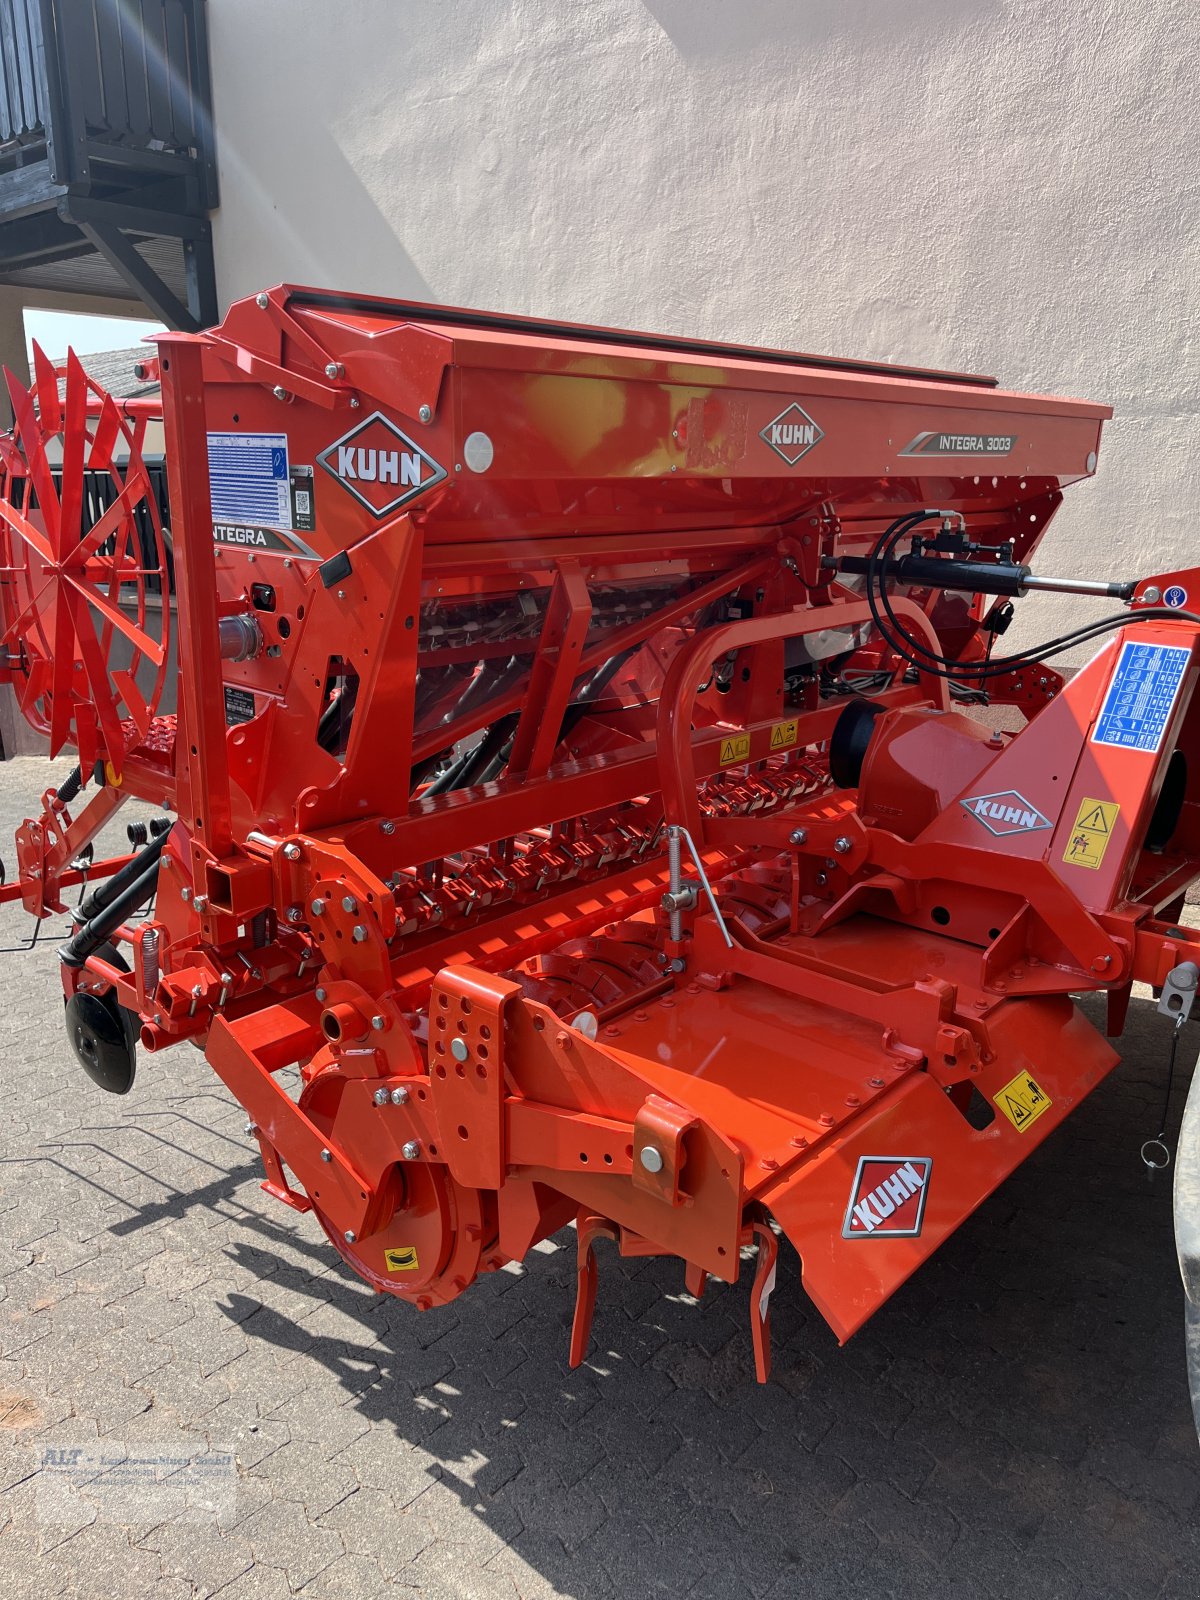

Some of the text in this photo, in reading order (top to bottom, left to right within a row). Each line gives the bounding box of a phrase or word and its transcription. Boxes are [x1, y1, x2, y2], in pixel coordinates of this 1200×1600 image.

[771, 424, 815, 445] KUHN
[939, 435, 1011, 451] INTEGRA 3003
[338, 446, 421, 487] KUHN
[213, 526, 267, 546] NTEGRA
[973, 800, 1038, 828] KUHN
[853, 1162, 924, 1232] KUHN
